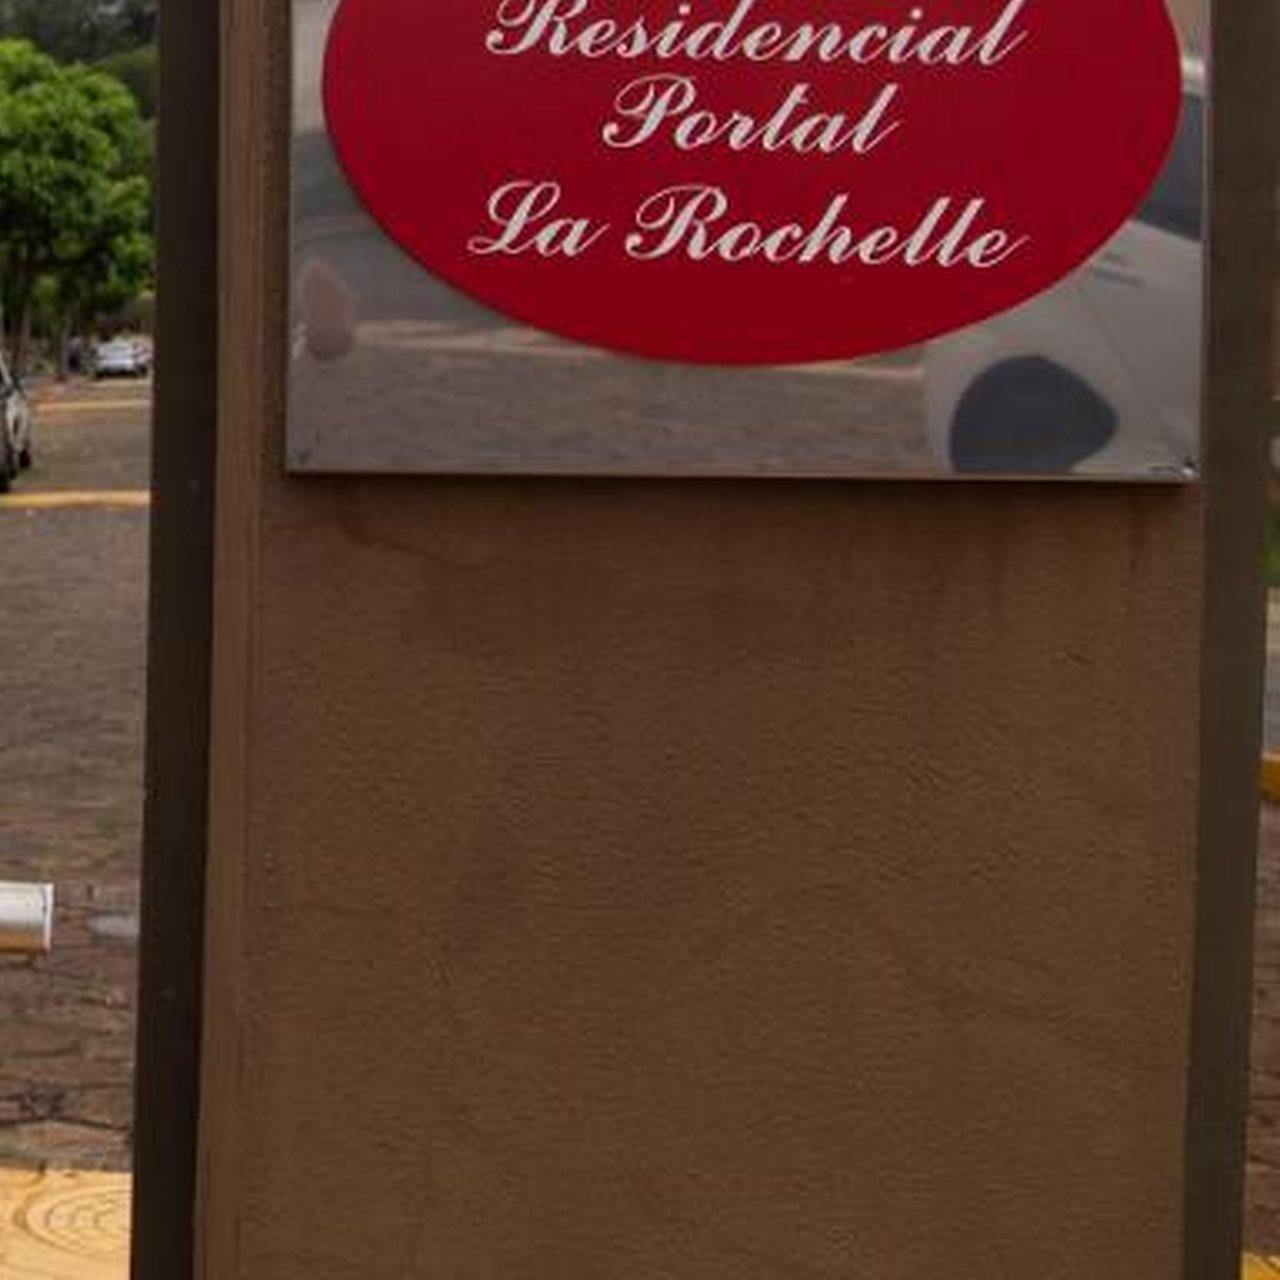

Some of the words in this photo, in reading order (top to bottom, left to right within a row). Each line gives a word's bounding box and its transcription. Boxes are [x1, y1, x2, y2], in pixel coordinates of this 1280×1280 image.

[601, 73, 902, 155] Portal
[466, 181, 610, 257] La
[625, 184, 1030, 268] Rochelle
